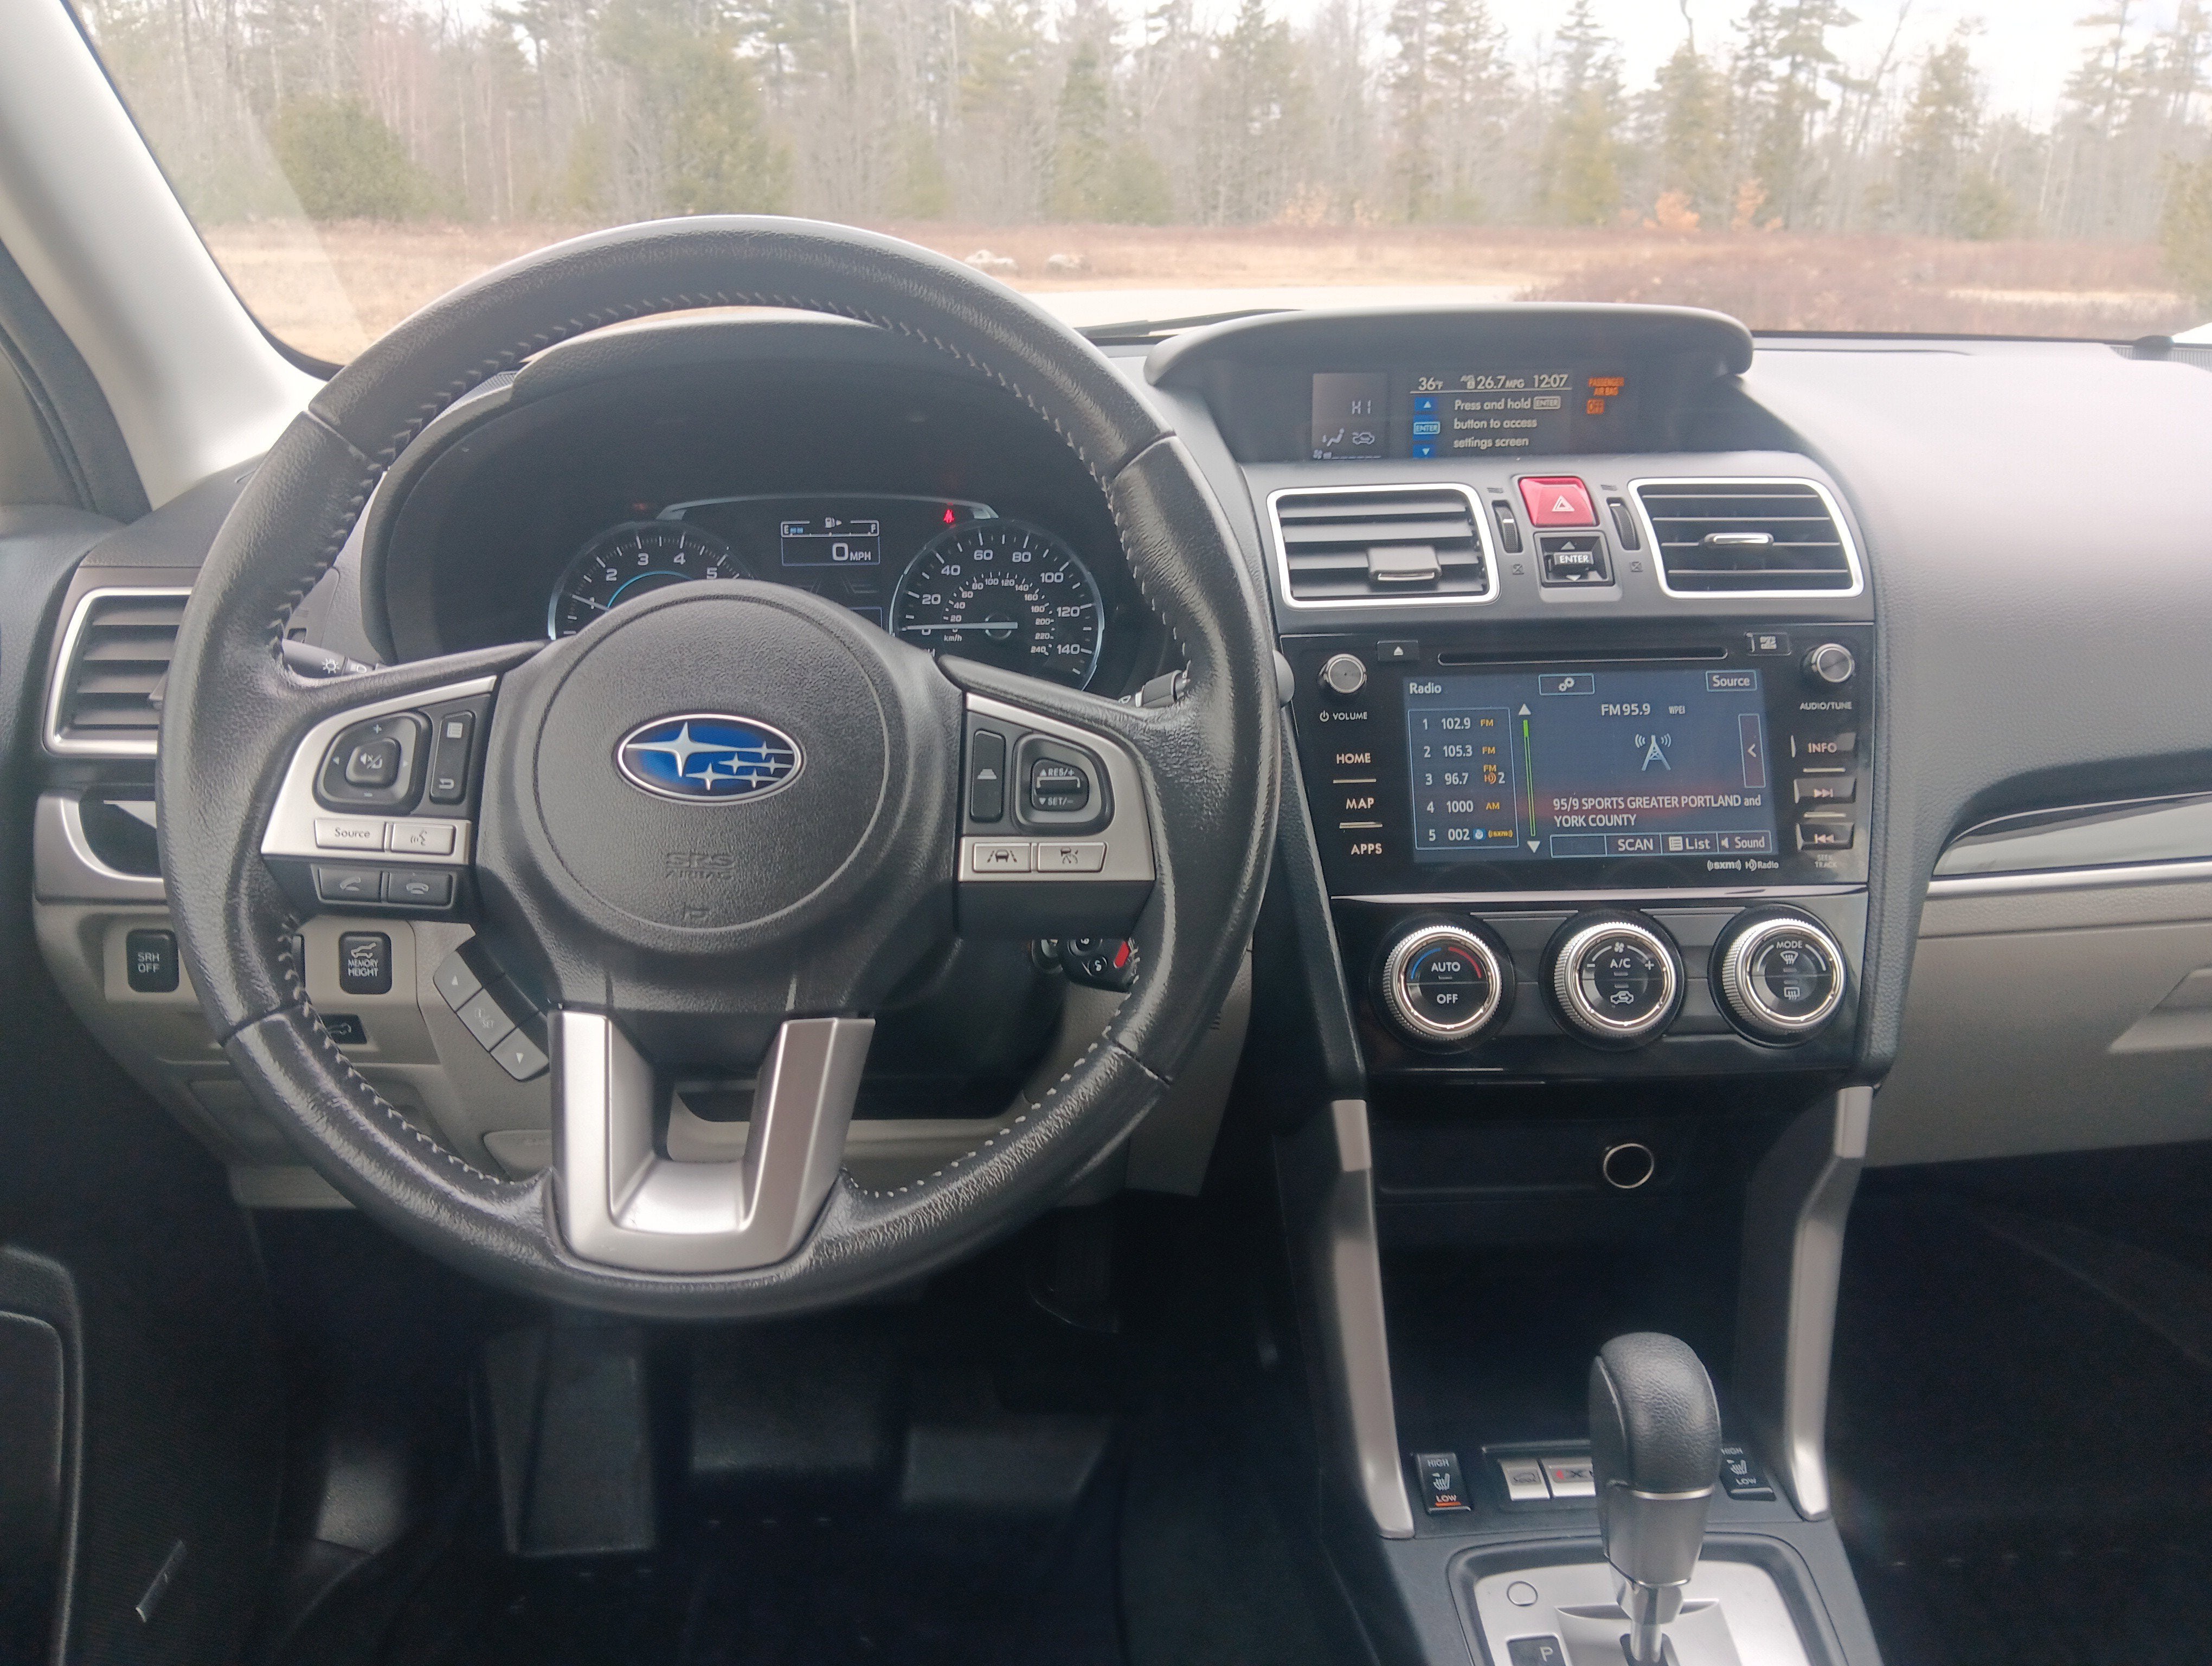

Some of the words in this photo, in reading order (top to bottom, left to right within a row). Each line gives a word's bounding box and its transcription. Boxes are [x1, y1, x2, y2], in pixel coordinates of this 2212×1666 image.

[1477, 375, 1506, 389] 26.7
[1454, 399, 1481, 411] Press
[1483, 398, 1505, 410] and
[1507, 398, 1531, 409] hold
[1535, 399, 1559, 407] ENTER
[1415, 424, 1438, 432] ENTER
[1454, 418, 1487, 429] button
[1490, 419, 1501, 428] to
[1503, 418, 1538, 428] access
[1453, 437, 1493, 450] settings
[1494, 437, 1529, 447] screen
[638, 553, 649, 566] 3
[673, 552, 686, 565] 4
[850, 551, 872, 561] MPH
[974, 549, 993, 561] 60
[1012, 552, 1031, 562] 80
[1559, 554, 1590, 564] ENTER
[606, 568, 618, 581] 2
[706, 567, 717, 579] 5
[941, 565, 961, 576] 40
[1040, 572, 1064, 583] 100
[922, 594, 941, 605] 20
[1057, 606, 1080, 617] 120
[1057, 644, 1080, 655] 140
[1713, 675, 1750, 687] Source
[1410, 682, 1442, 694] Radio
[1601, 704, 1621, 716] FM
[1622, 703, 1651, 715] 95.9
[1799, 702, 1852, 710] AUDIO/TUNE
[1333, 711, 1368, 720] VOLUME
[1423, 719, 1427, 730] 1
[1442, 717, 1471, 730] 102.9
[1424, 746, 1431, 758] 2
[1443, 745, 1472, 757] 105.3
[1482, 746, 1496, 754] FM
[1808, 743, 1837, 753] INFO
[1336, 753, 1371, 764] HOME
[1425, 773, 1432, 785] 3
[1444, 772, 1469, 785] 96.7
[1346, 798, 1374, 809] MAP
[1426, 801, 1435, 813] 4
[1446, 800, 1474, 813] 1000
[1486, 802, 1500, 810] AM
[1553, 797, 1579, 812] 95/9
[1582, 797, 1625, 810] SPORTS
[1627, 796, 1679, 809] GREATER
[1681, 794, 1741, 808] PORTLAND
[1744, 794, 1761, 806] and
[1554, 815, 1586, 827] YORK
[1589, 814, 1636, 826] COUNTY
[335, 827, 370, 838] Source
[1429, 829, 1436, 841] 5
[1448, 829, 1470, 841] 002
[1351, 843, 1382, 855] APPS
[1618, 839, 1653, 851] SCAN
[1686, 838, 1711, 850] List
[1735, 837, 1765, 849] Sound
[1758, 861, 1779, 869] Radio
[1776, 940, 1803, 949] MODE
[138, 952, 159, 962] SRH
[138, 963, 160, 973] OFF
[348, 959, 378, 967] MEMORY
[1431, 962, 1461, 972] AUTO
[1610, 958, 1631, 968] A/C
[348, 967, 378, 976] HEIGHT
[1437, 994, 1458, 1004] OFF
[1427, 1458, 1449, 1468] HIGH
[1540, 1646, 1553, 1662] P
